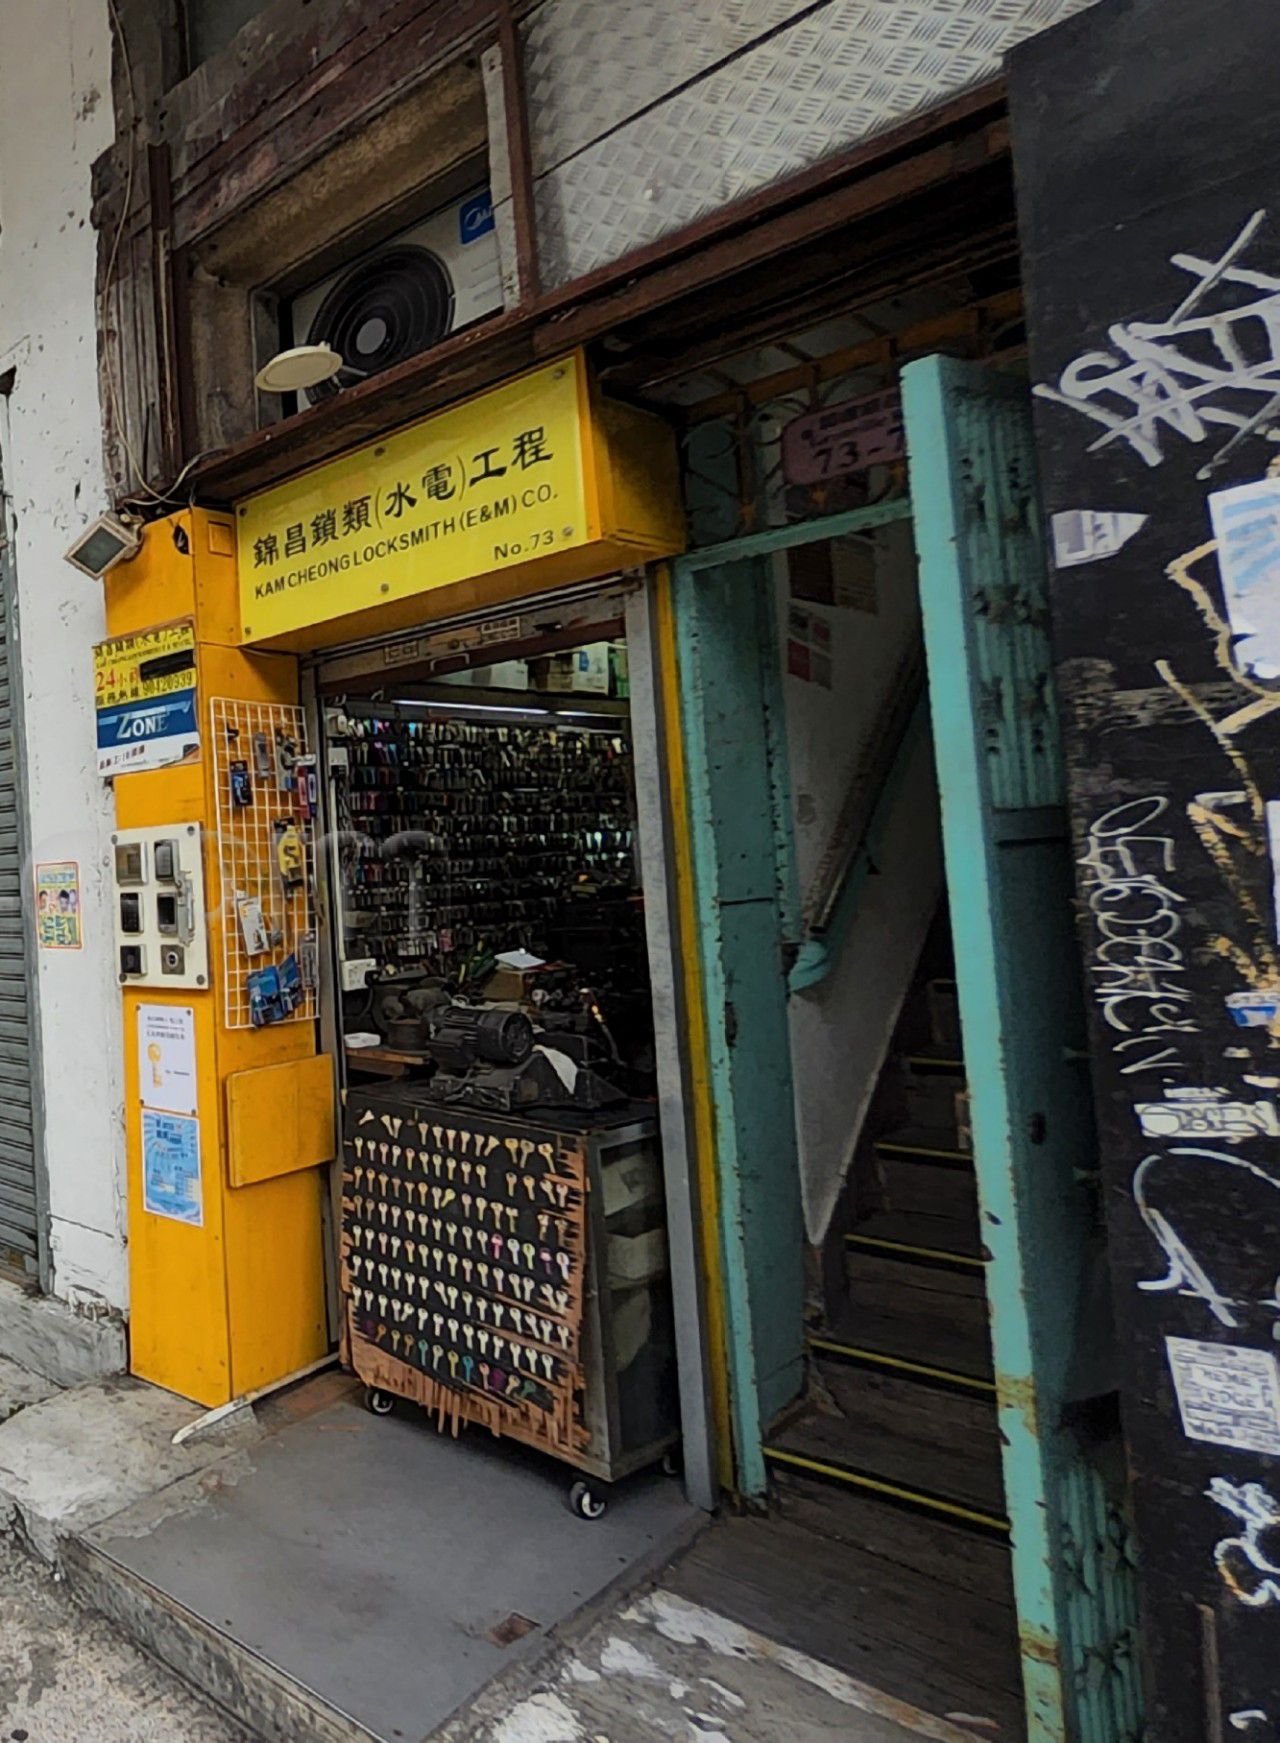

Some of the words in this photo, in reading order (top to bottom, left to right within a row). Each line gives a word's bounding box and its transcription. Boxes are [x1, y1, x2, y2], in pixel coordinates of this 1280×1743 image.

[252, 426, 554, 569] 錦昌鎖類(水電)工程
[254, 576, 286, 600] KAM
[287, 554, 351, 588] CHEONG
[353, 519, 456, 567] LOCKSMITH
[460, 493, 518, 533] (E&M)
[521, 483, 559, 508] CO.
[117, 711, 169, 739] ZONE
